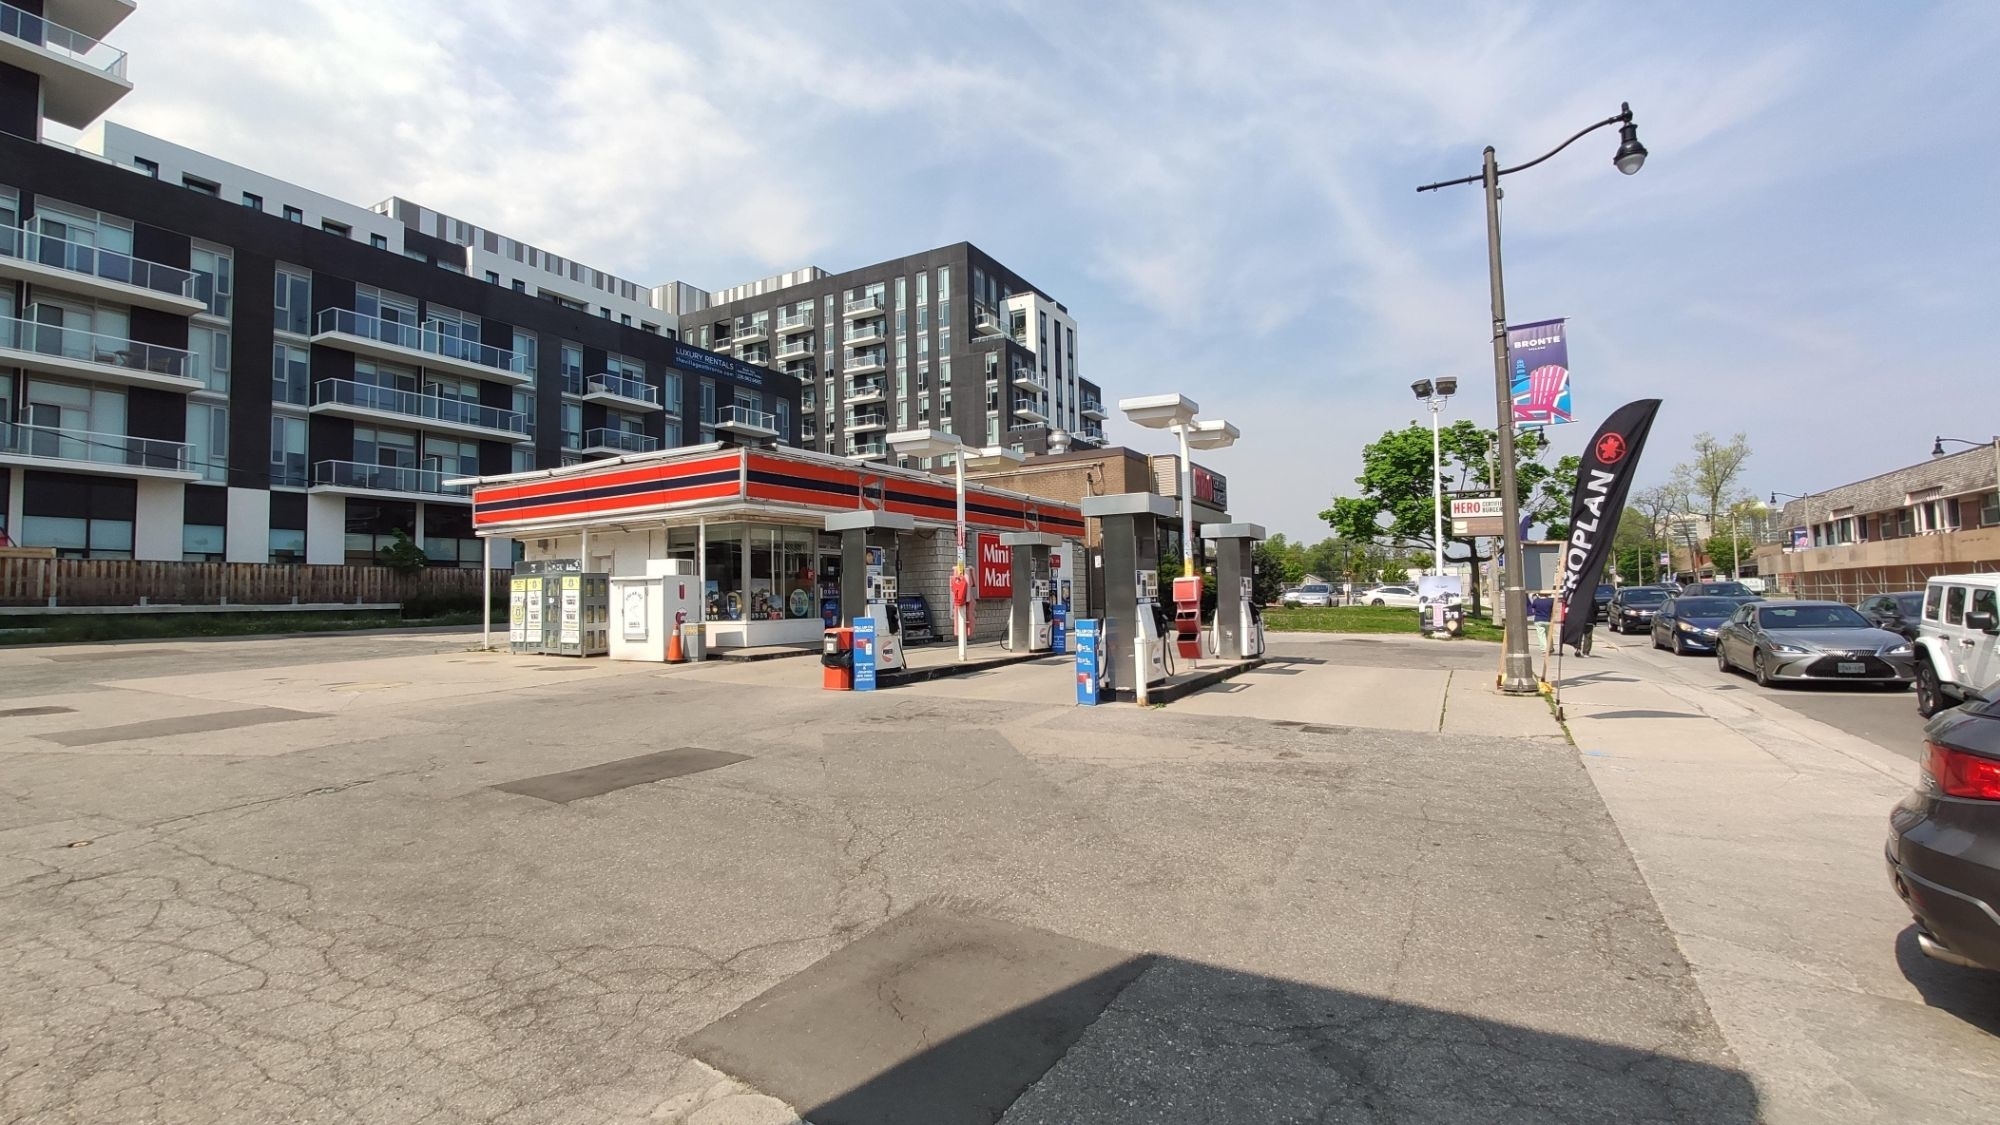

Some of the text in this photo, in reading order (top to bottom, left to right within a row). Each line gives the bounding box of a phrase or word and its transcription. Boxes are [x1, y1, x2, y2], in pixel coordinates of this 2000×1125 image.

[1514, 336, 1561, 349] BRONTE
[675, 347, 734, 370] LUXURY RENTALS
[1453, 502, 1481, 514] HERO
[983, 543, 1009, 564] Mini
[984, 568, 1011, 587] Mart
